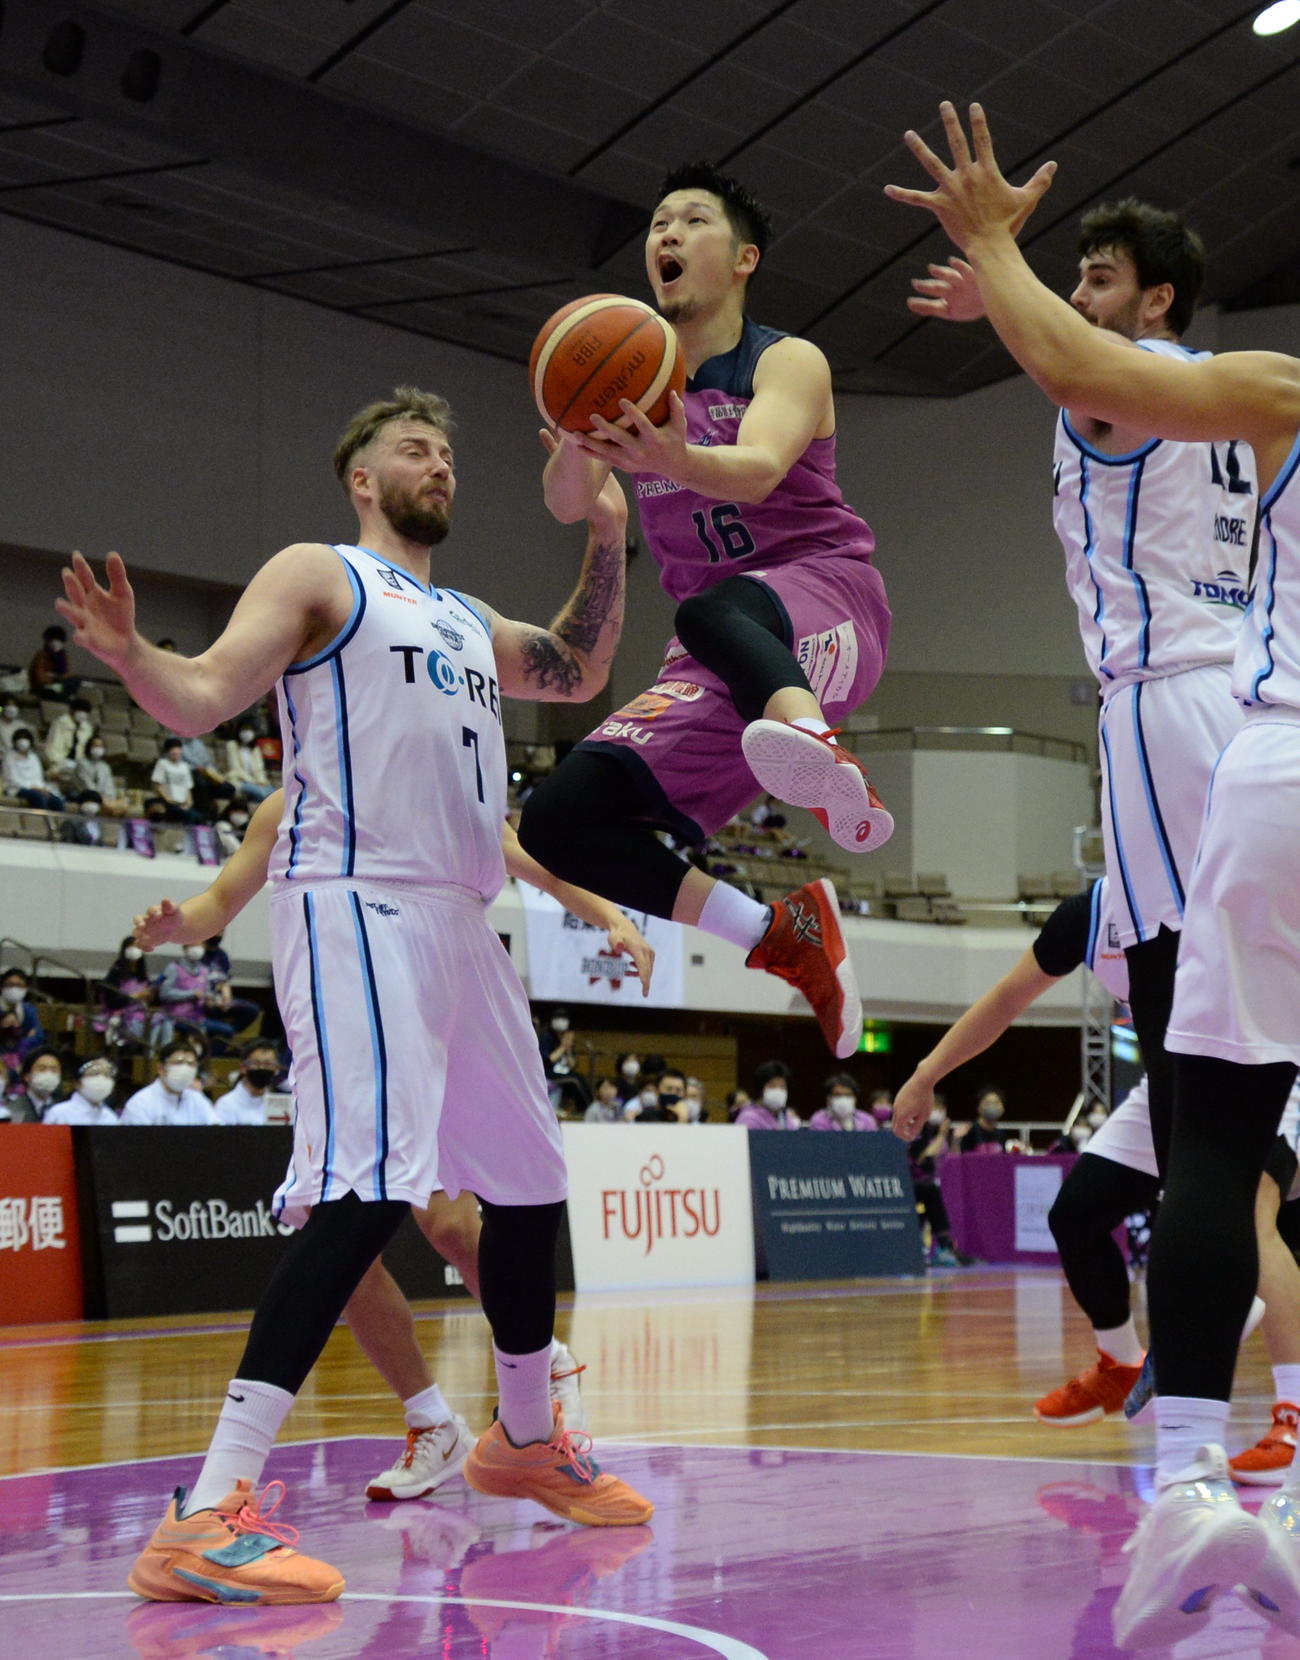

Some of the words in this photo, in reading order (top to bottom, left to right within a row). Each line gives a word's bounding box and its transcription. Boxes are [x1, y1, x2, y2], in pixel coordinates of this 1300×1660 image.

[593, 350, 646, 408] molten
[692, 502, 756, 565] 16
[462, 725, 485, 804] 7
[767, 1174, 847, 1200] PREMIUM
[848, 1174, 905, 1199] WATER
[155, 1199, 276, 1241] SoftBank
[600, 1186, 721, 1257] FUJITSU
